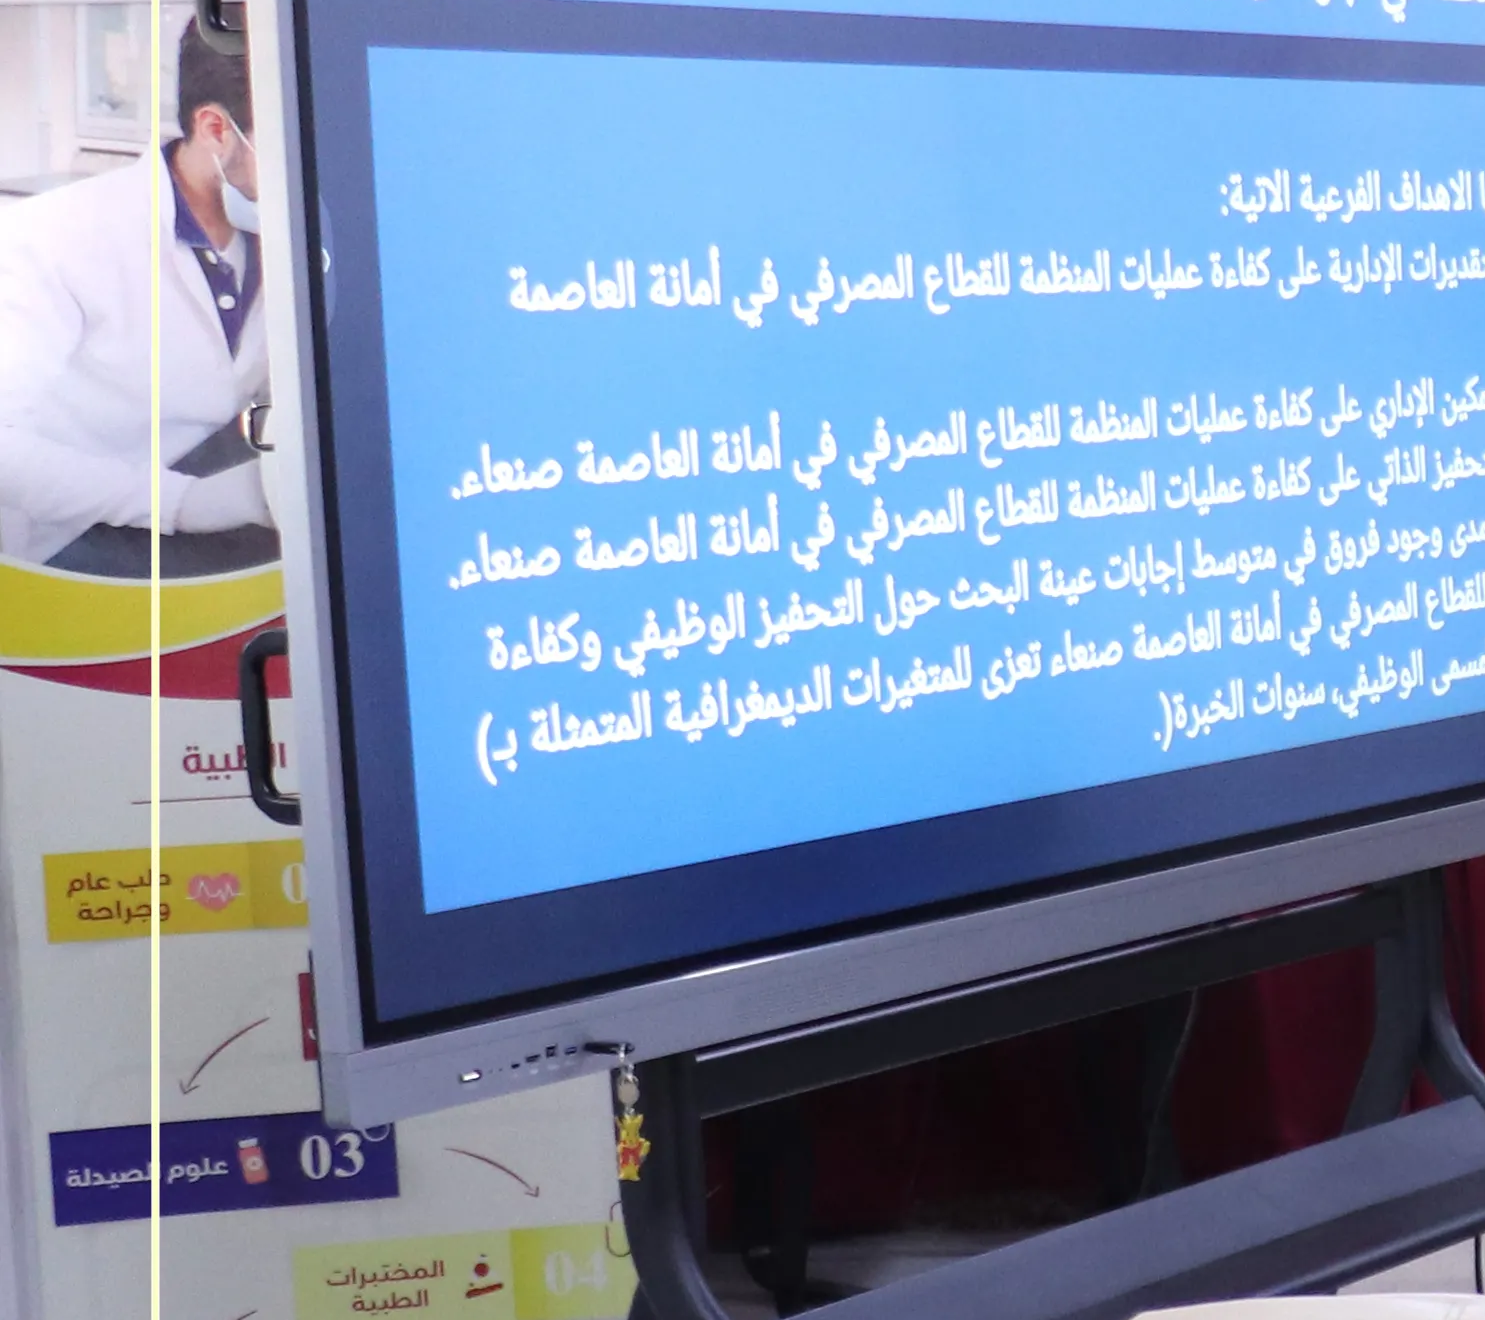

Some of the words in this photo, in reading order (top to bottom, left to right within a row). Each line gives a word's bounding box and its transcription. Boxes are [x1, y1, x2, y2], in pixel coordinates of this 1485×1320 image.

[1299, 170, 1381, 223] الفرعية
[1387, 170, 1472, 212] الاهداف
[509, 259, 636, 312] العاصمة
[648, 244, 721, 307] أمانة
[732, 258, 779, 329] في
[790, 253, 914, 326] المصرفي
[923, 251, 1011, 315] للقطاع
[1019, 249, 1111, 294] المنظمة
[1119, 248, 1203, 300] عمليات
[1209, 247, 1271, 289] كفاءة
[1277, 246, 1322, 300] على
[1328, 242, 1402, 294] الإدارية
[65, 1158, 151, 1189] لصيدلة
[299, 1133, 365, 1179] 03
[326, 1257, 446, 1290] المختبرات
[351, 1289, 431, 1314] الطبية
